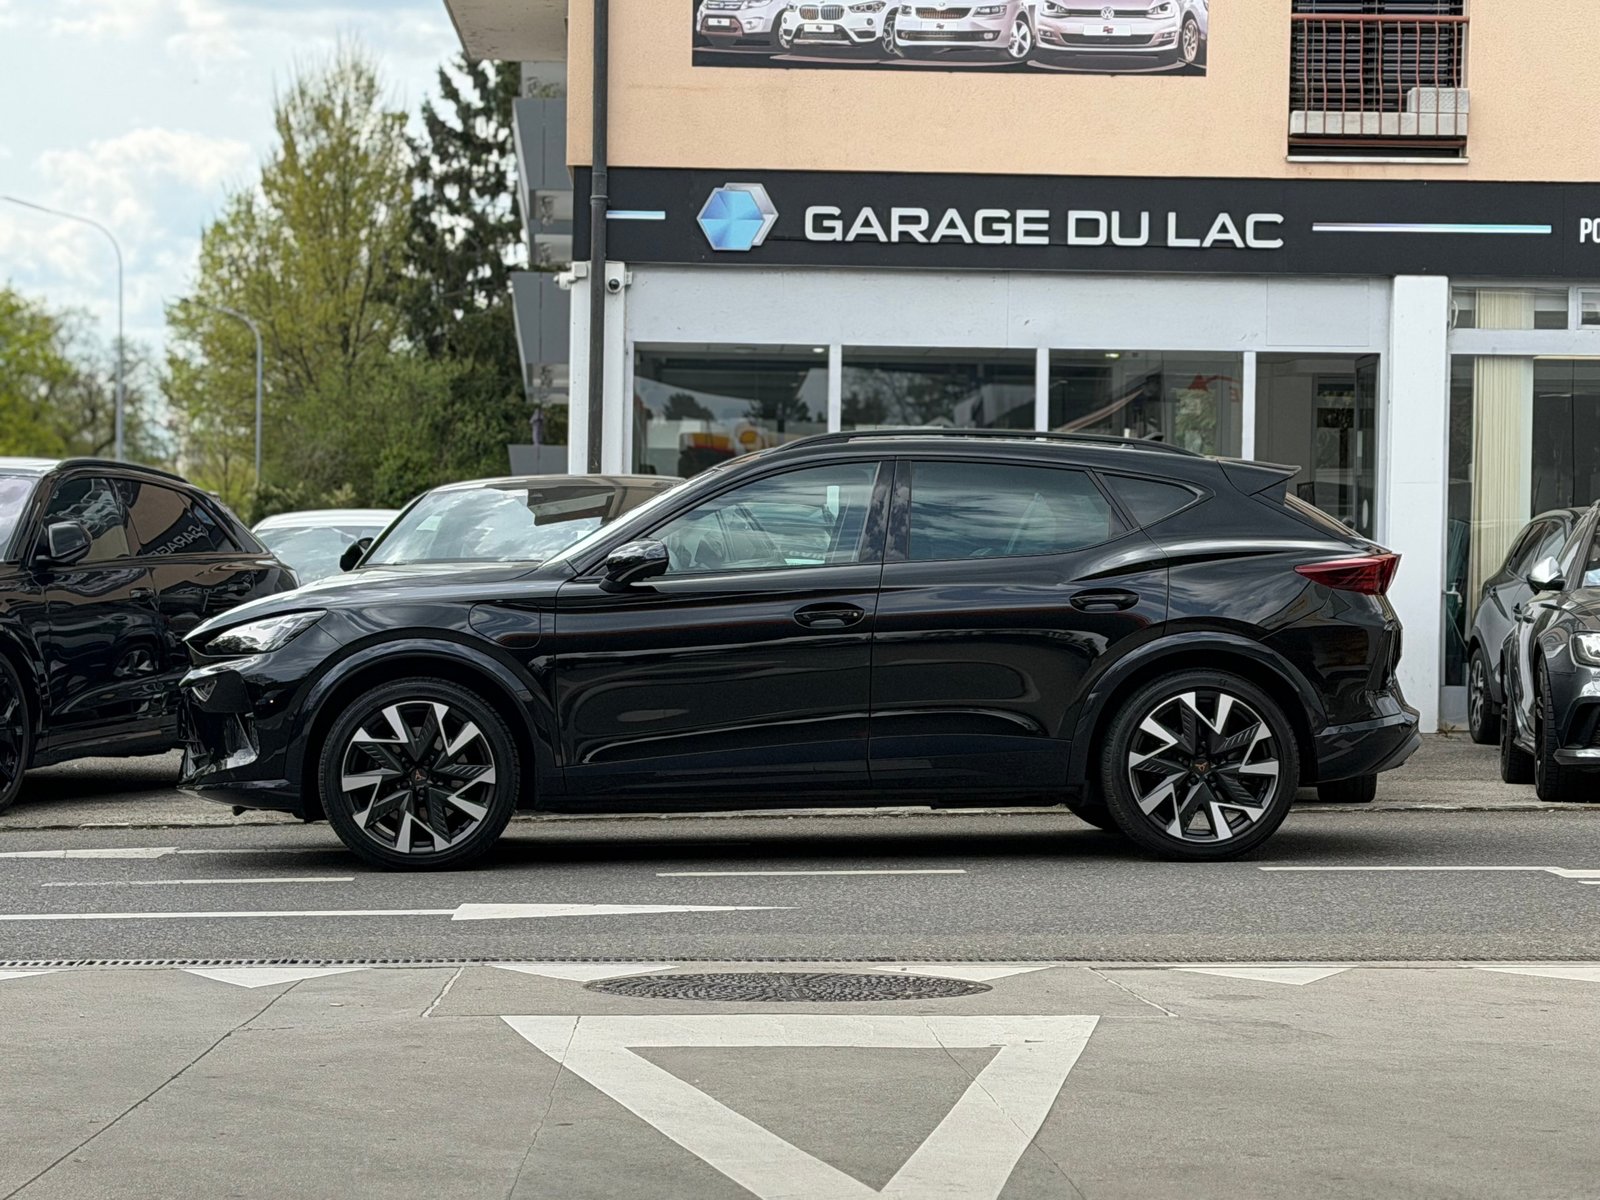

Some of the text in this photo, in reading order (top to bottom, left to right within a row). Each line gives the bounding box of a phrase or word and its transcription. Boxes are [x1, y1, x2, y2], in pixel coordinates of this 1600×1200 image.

[804, 205, 1285, 249] GARAGE DU LAC
